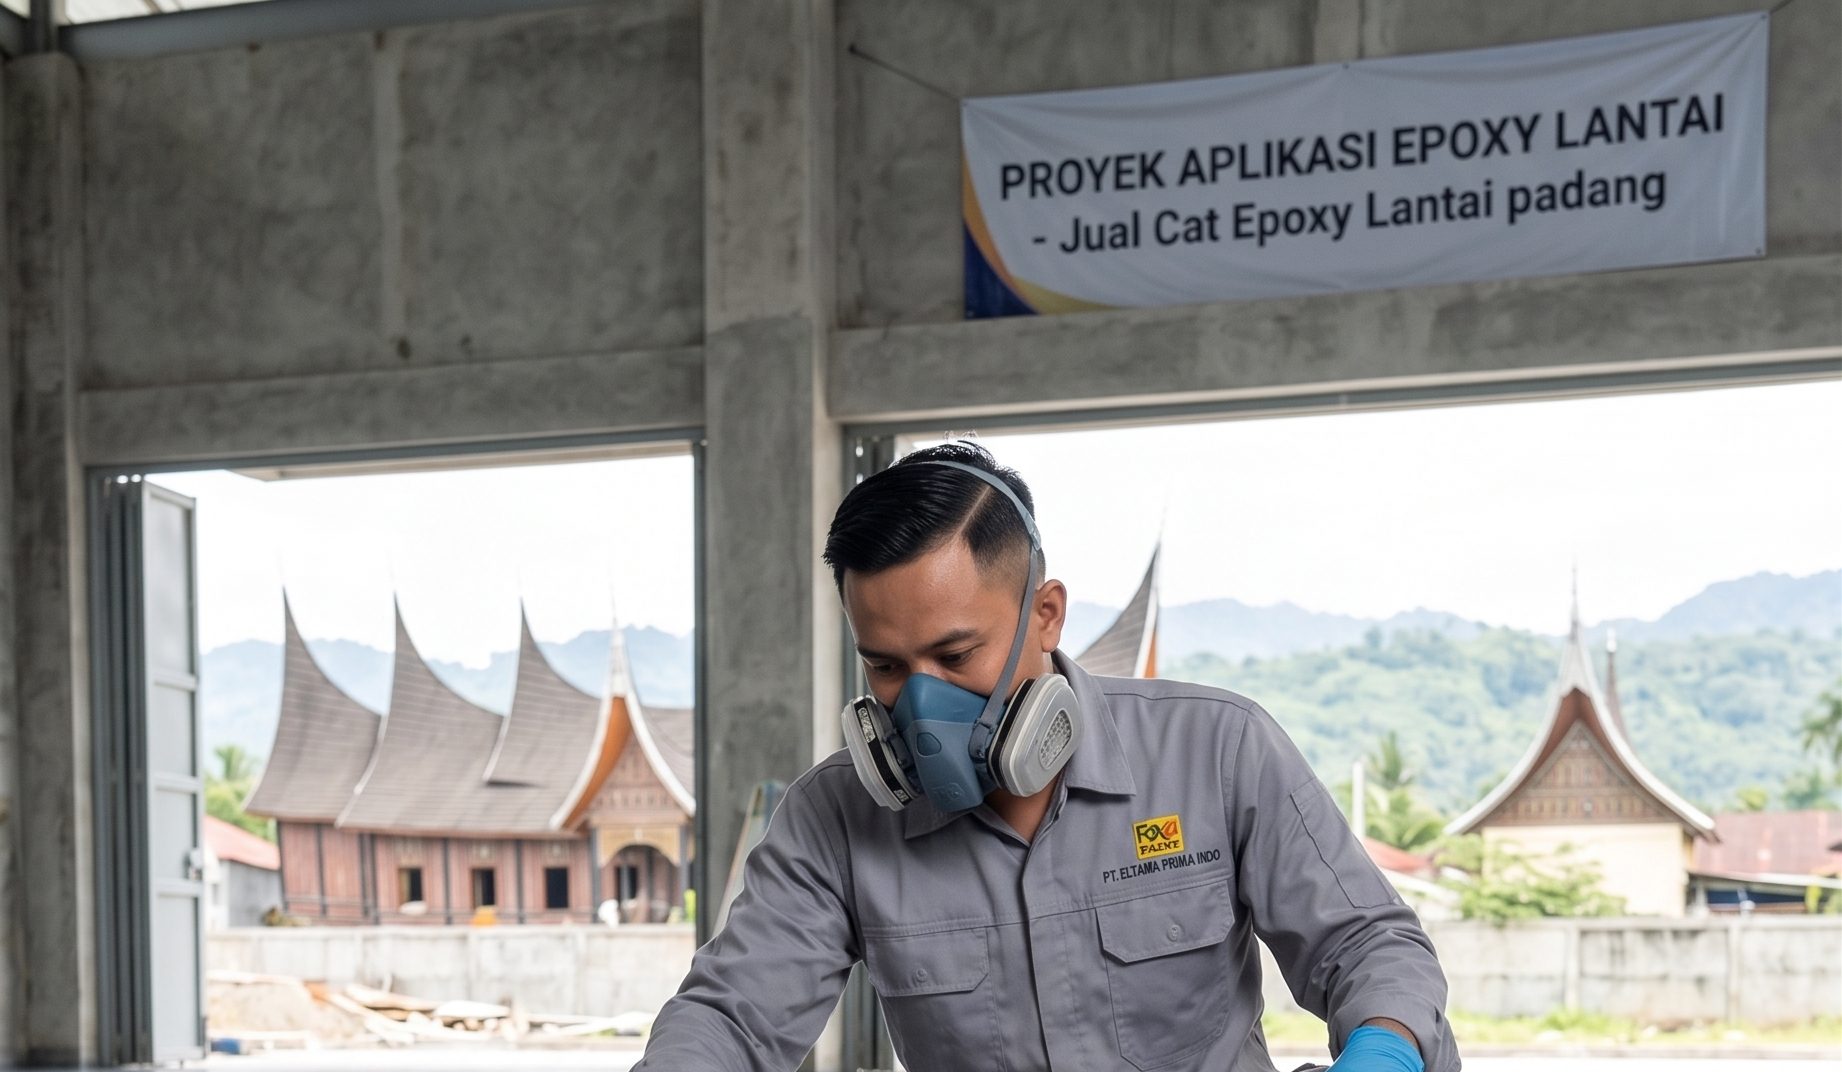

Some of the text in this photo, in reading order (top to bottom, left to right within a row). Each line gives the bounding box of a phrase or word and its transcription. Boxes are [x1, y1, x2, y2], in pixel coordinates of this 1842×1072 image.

[1001, 93, 1723, 200] PROYEK APLIKASI EPOXY LANTAI
[1032, 169, 1665, 253] - Jual Cat Epoxy Lantai padang
[1103, 849, 1220, 883] PT. ELTAMA PRIMA INDO
